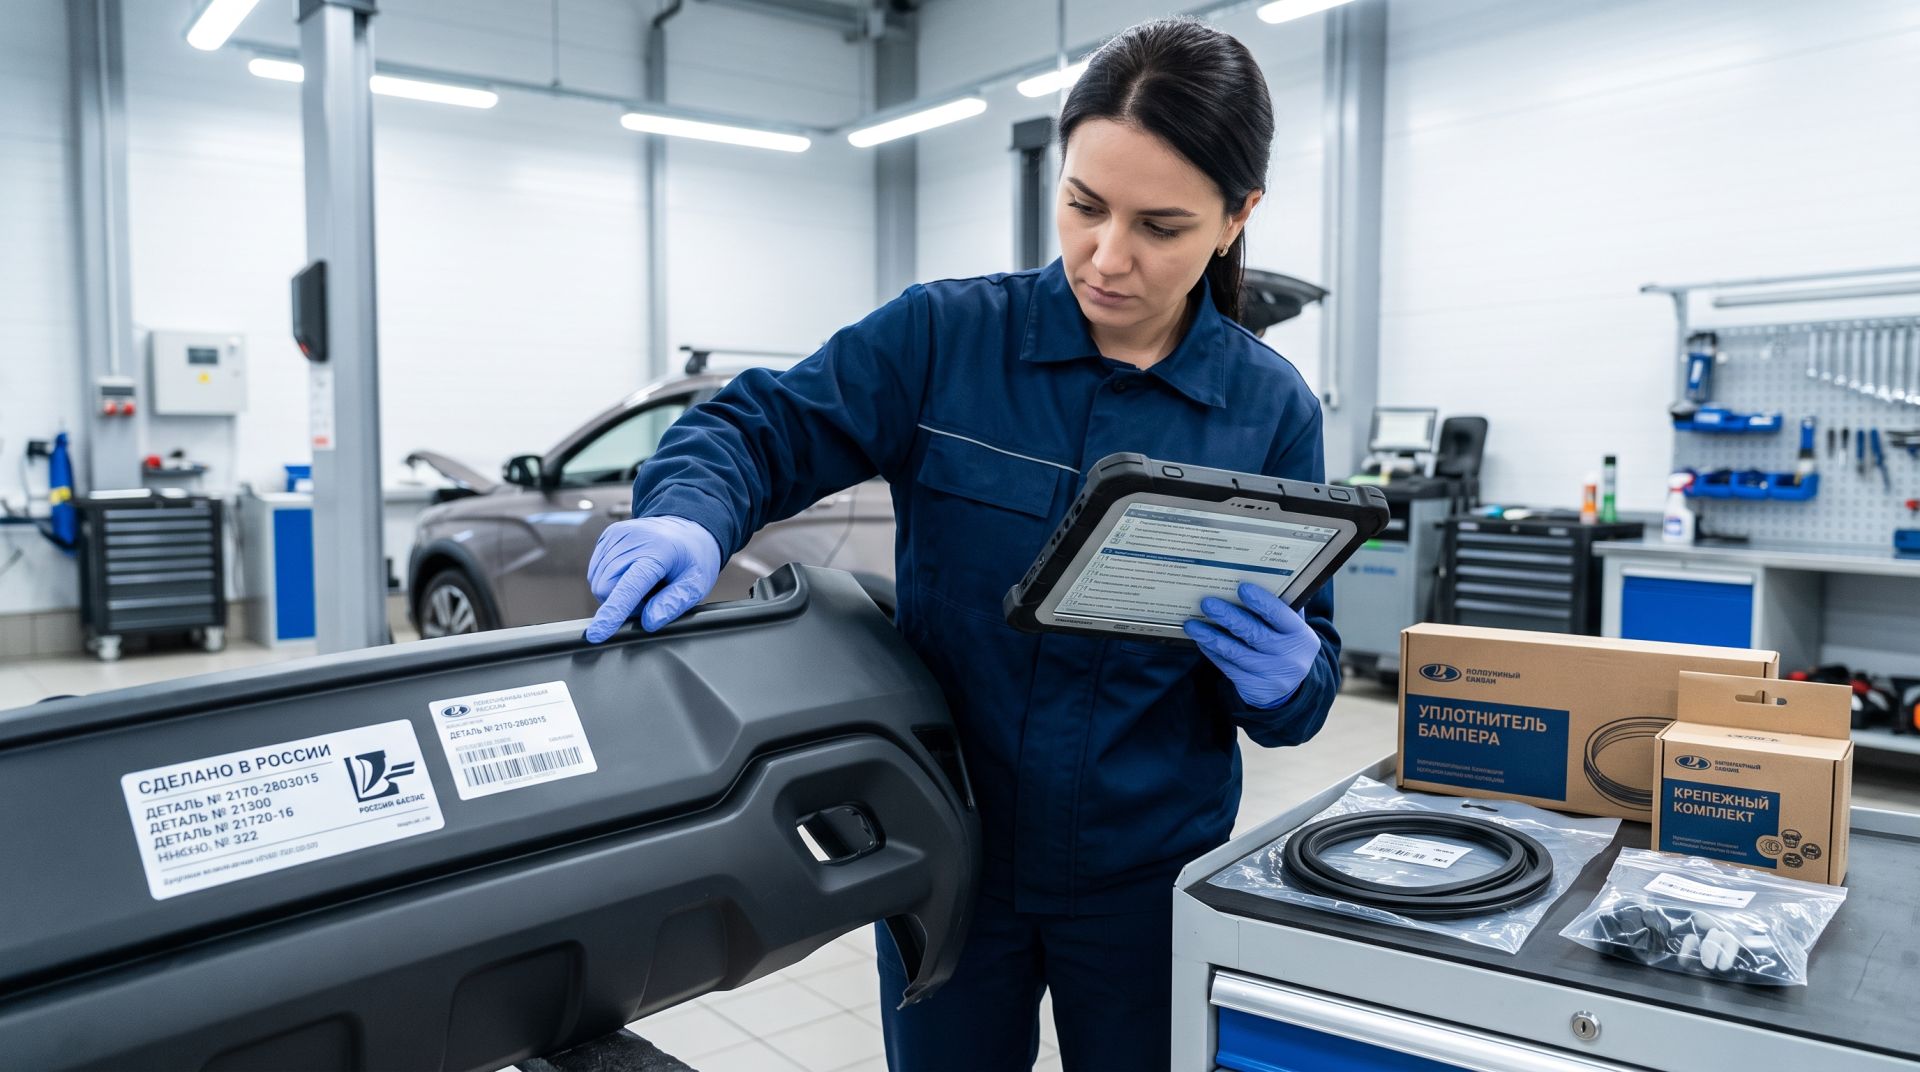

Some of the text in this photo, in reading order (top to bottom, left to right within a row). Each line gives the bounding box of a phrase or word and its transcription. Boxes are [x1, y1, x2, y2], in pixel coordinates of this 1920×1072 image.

[1419, 704, 1547, 733] УПЛОТНИТЕЛЬ
[450, 727, 482, 740] ДЕТАЛЬ
[1418, 723, 1500, 746] БАМПЕРА
[139, 744, 331, 794] СДЕЛАНО В РОССИИ
[146, 773, 319, 820] ДЕТАЛЬ № 2170-2803015
[1674, 787, 1769, 811] КРЕПЕЖНЫЙ
[150, 797, 271, 835] ДЕТАЛЬ № 21300
[1673, 802, 1755, 823] КОМПЛЕКТ
[154, 807, 294, 850] ДЕТАЛЬ № 21720-16
[215, 837, 229, 849] №
[234, 831, 259, 845] 322
